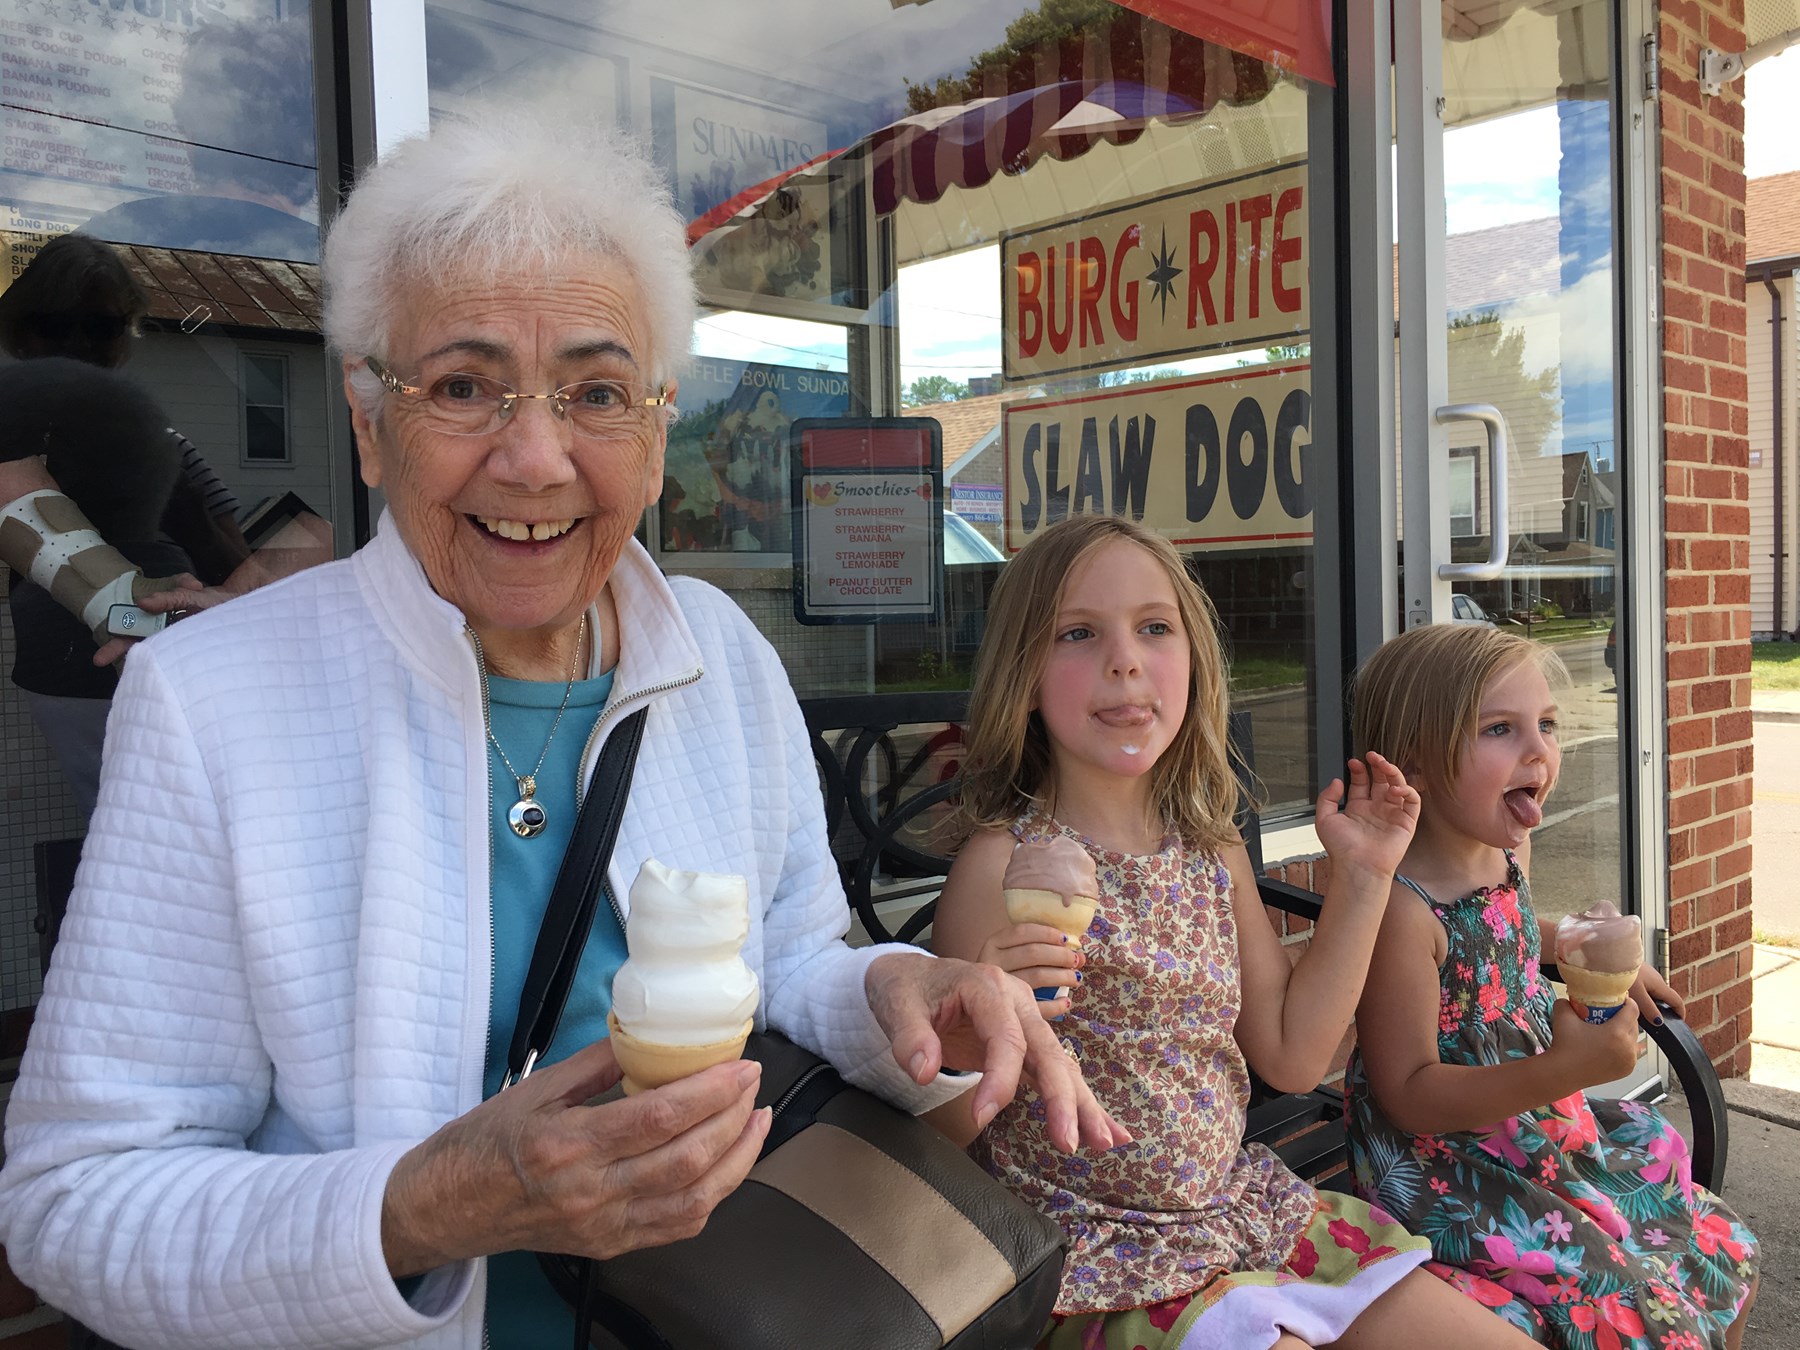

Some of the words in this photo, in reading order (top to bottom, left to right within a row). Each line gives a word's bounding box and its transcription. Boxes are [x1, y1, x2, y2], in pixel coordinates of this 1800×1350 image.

[59, 31, 84, 43] CUP
[0, 34, 26, 48] TER
[31, 40, 79, 58] COOKIE
[83, 50, 127, 67] DOUGH
[1, 52, 53, 71] BANANA
[57, 63, 91, 77] SPLIT
[2, 68, 53, 87] BANANA
[57, 79, 111, 98] PUDDING
[2, 85, 53, 104] BANANA
[4, 117, 61, 135] S'MORES
[4, 136, 89, 157] STRAWBERRY
[4, 146, 40, 160] OREO
[46, 152, 128, 175] CHEESECAKE
[3, 158, 64, 177] CARAMEL
[67, 167, 123, 185] BROWNIE
[10, 218, 41, 229] LONG
[46, 222, 71, 233] DOG
[1017, 223, 1141, 360] BURG
[1186, 186, 1304, 330] RITE
[672, 362, 734, 385] AFFLE
[741, 370, 791, 390] BOWL
[1019, 412, 1157, 535] SLAW
[1185, 388, 1314, 524] DOG
[834, 508, 904, 517] STRAWBERRY
[835, 525, 905, 534] STRAWBERRY
[849, 534, 892, 543] BANANA
[835, 551, 906, 560] STRAWBERRY
[841, 560, 900, 569] LEMONADE
[828, 577, 870, 587] PEANUT
[872, 577, 913, 587] BUTTER
[839, 586, 903, 596] CHOCOLATE
